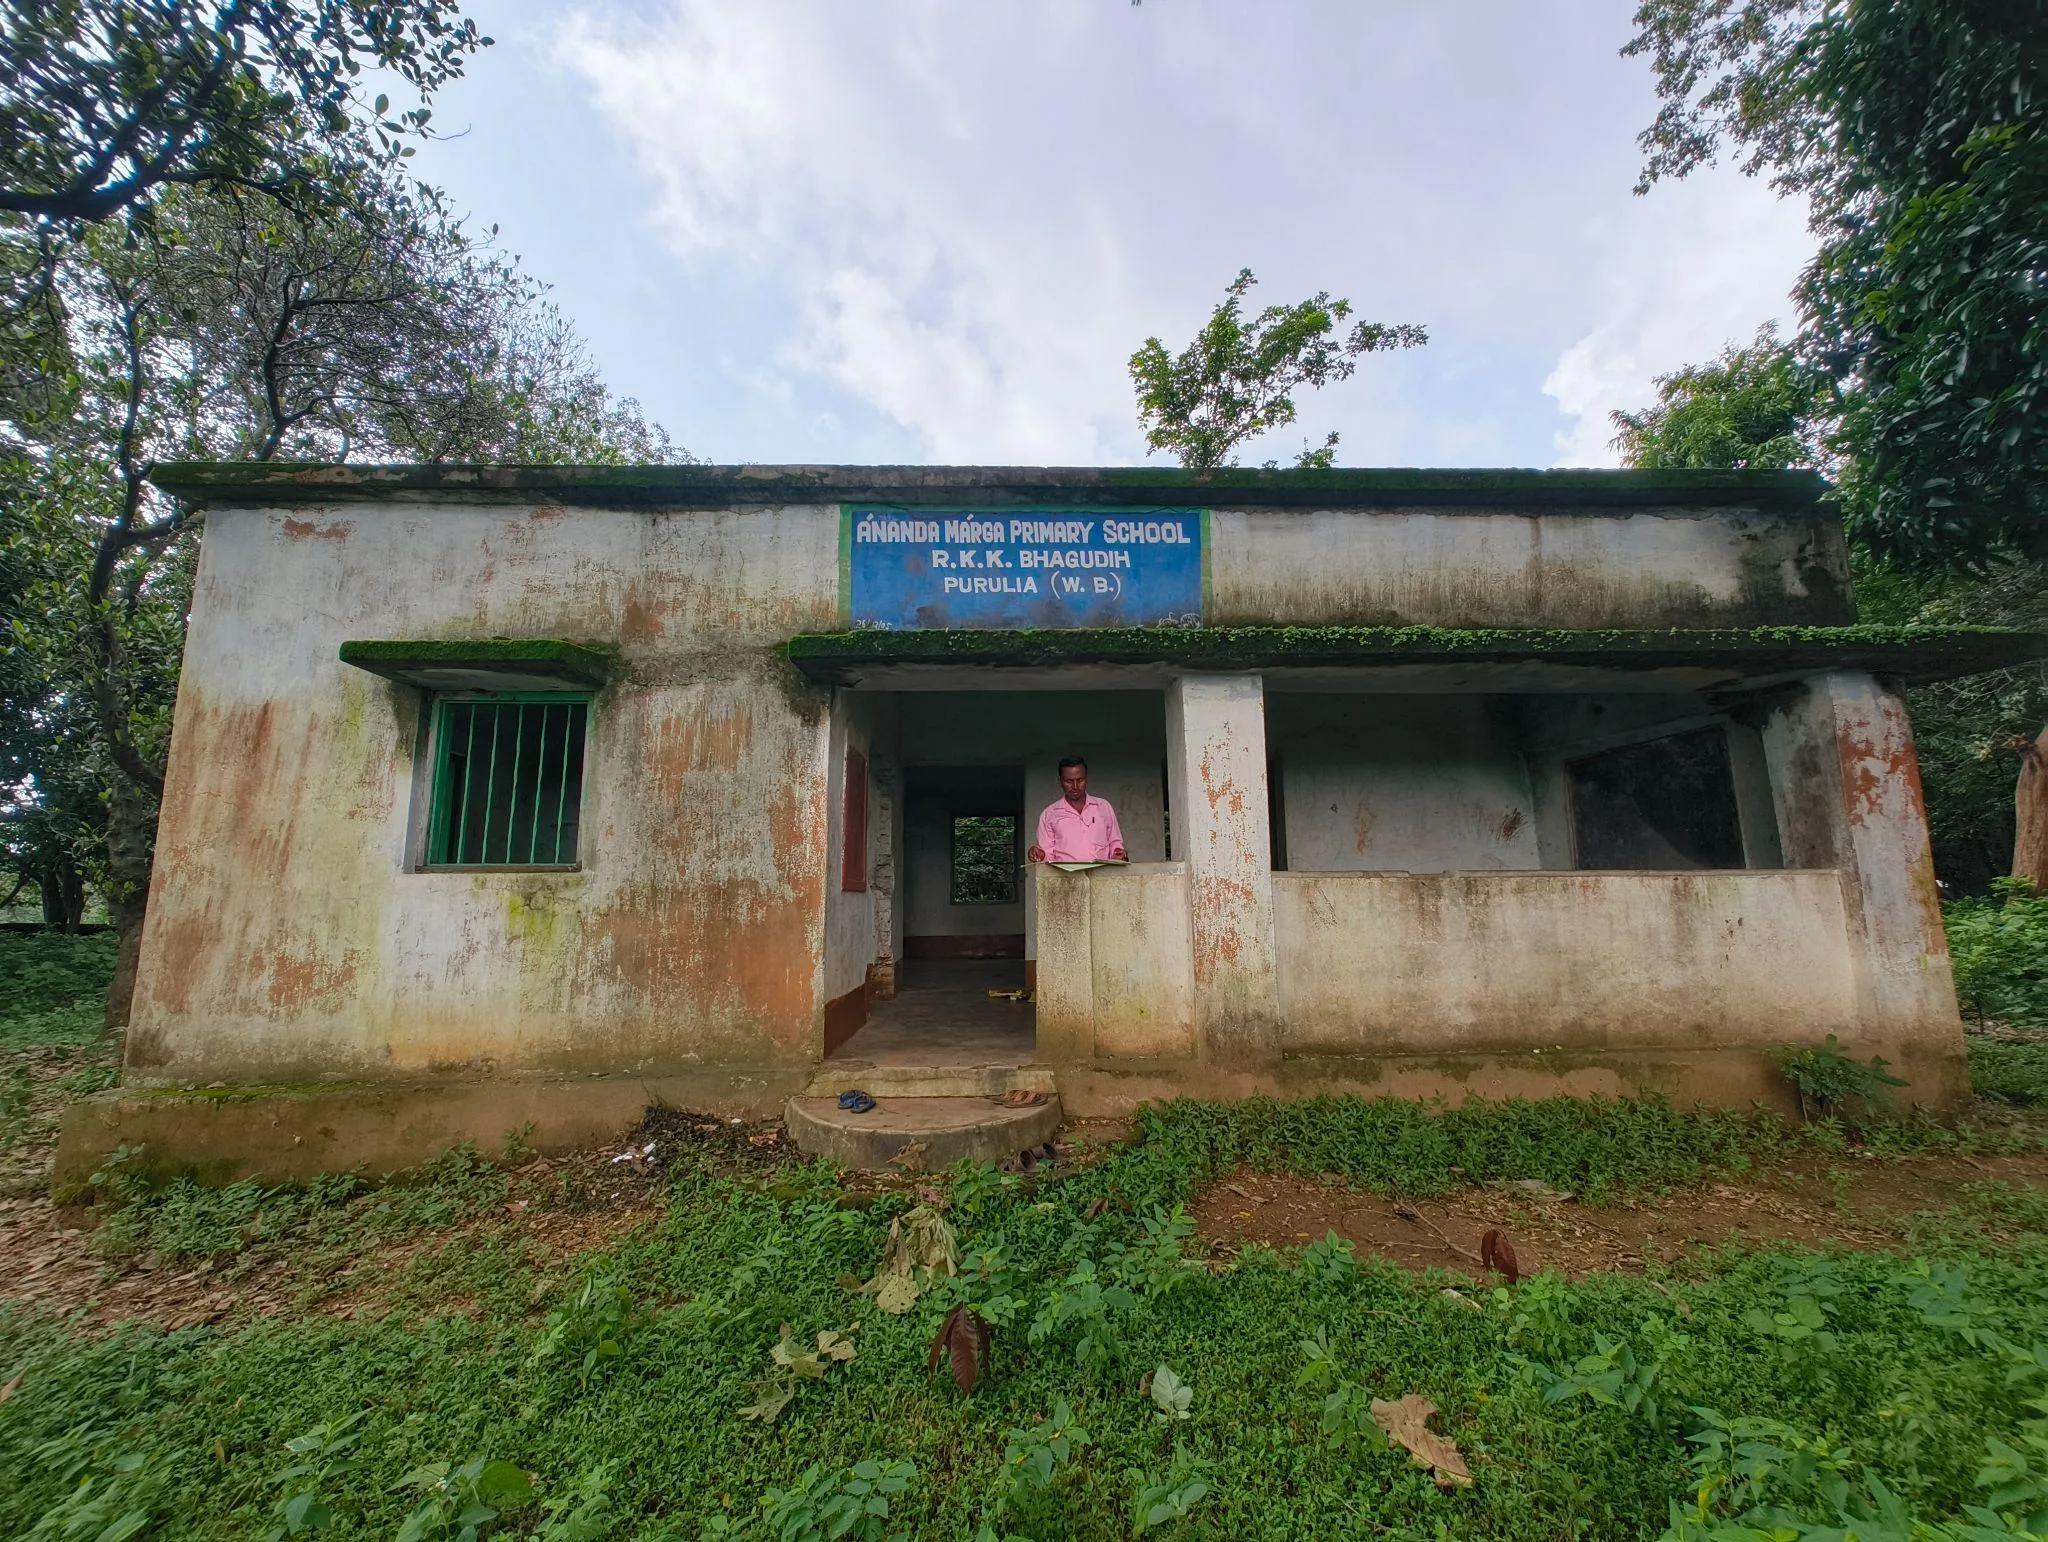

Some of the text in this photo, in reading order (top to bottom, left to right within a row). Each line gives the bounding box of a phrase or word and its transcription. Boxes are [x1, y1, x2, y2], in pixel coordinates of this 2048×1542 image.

[1009, 519, 1095, 544] PRIMARY
[1102, 519, 1191, 544] SCHOOL
[931, 549, 1131, 569] R.K.K. BHAGUDIH
[944, 576, 1038, 594] PURULIA
